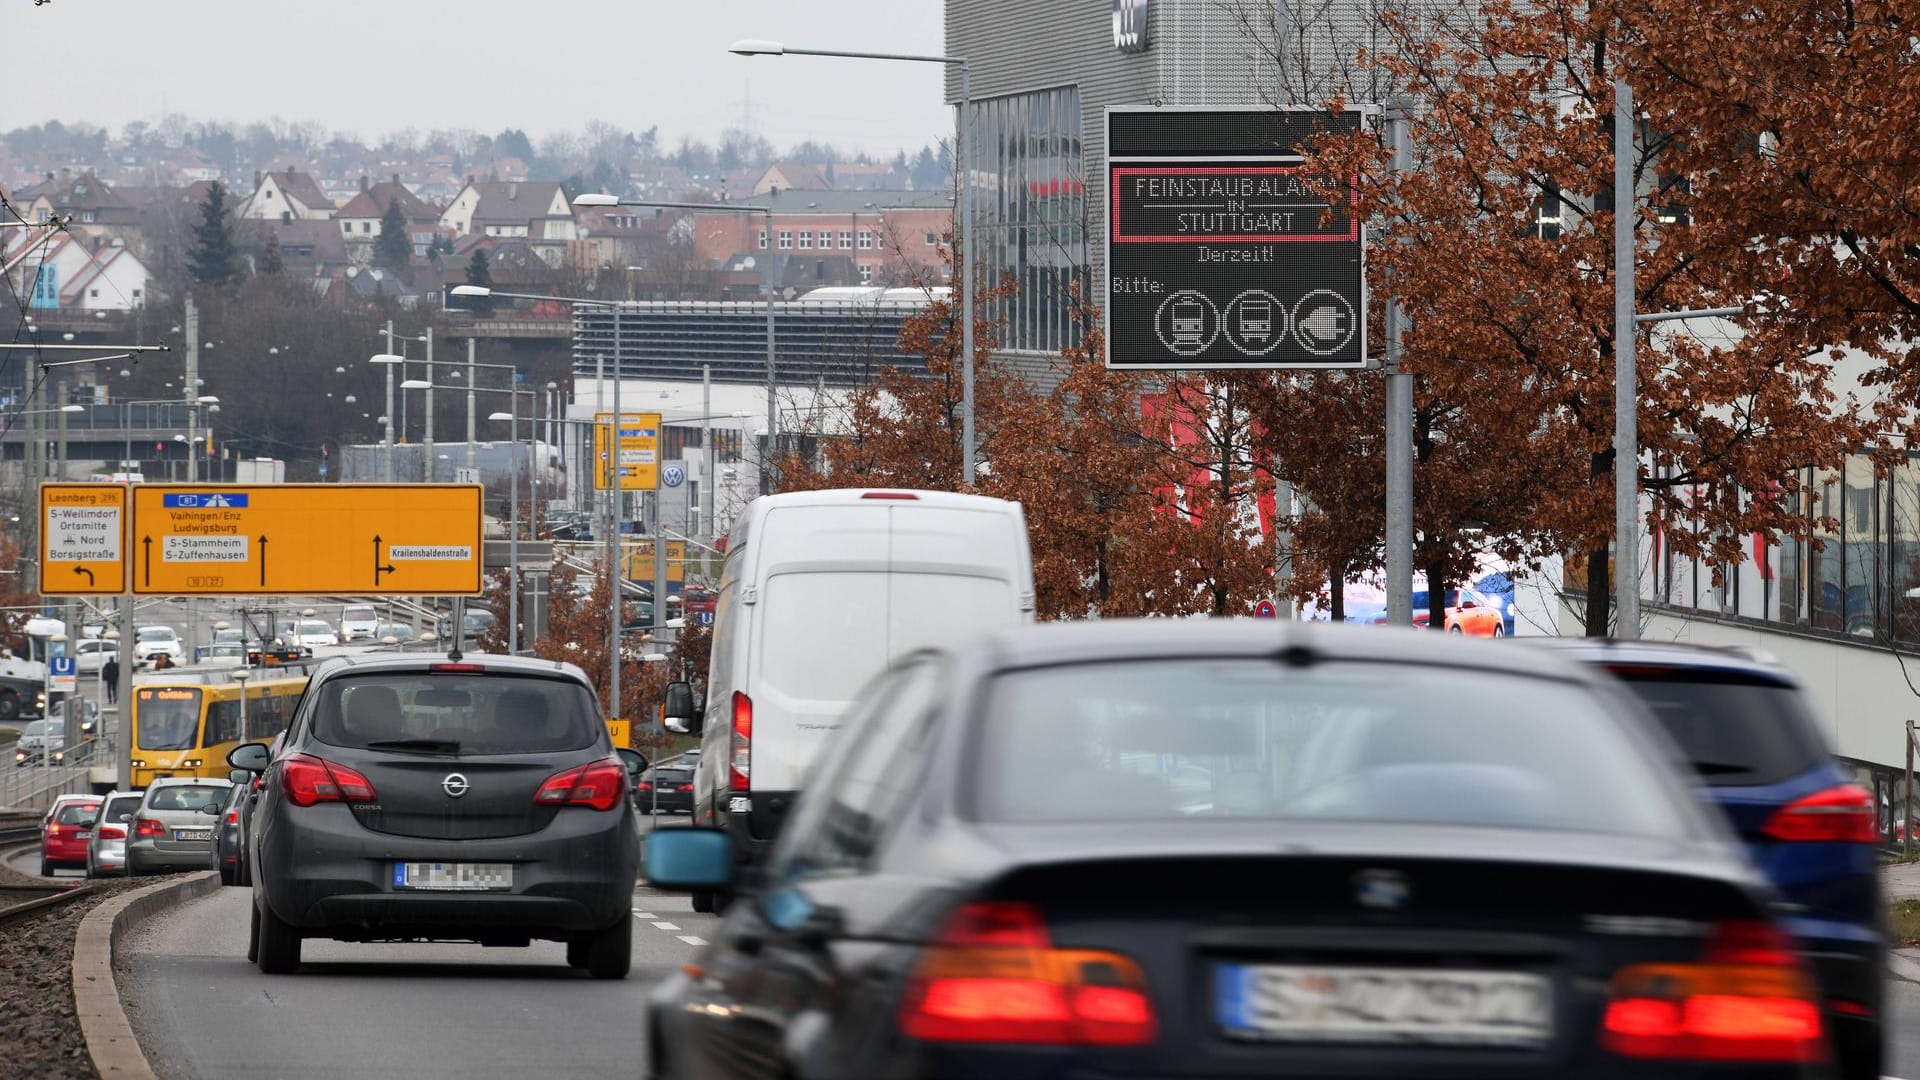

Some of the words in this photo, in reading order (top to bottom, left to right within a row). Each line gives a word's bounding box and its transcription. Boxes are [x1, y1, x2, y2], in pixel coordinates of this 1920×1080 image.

[1228, 200, 1244, 211] IN
[1178, 211, 1296, 232] STUTTGART
[1198, 246, 1273, 262] Derzeit!
[1113, 277, 1164, 292] Bitte:
[48, 493, 96, 504] Leonberg
[50, 509, 117, 518] S-Weilimdorf
[170, 511, 242, 522] Vaihingen/Enz
[60, 521, 107, 530] Ortsmitte
[173, 524, 237, 534] Ludwigsburg
[80, 536, 105, 545] Nord
[170, 538, 241, 547] S-Stammheim
[50, 549, 115, 560] Borsigstraße
[166, 550, 245, 560] S-Zuffenhausen
[392, 548, 469, 558] Krailenshaldenstraße
[56, 657, 70, 672] U
